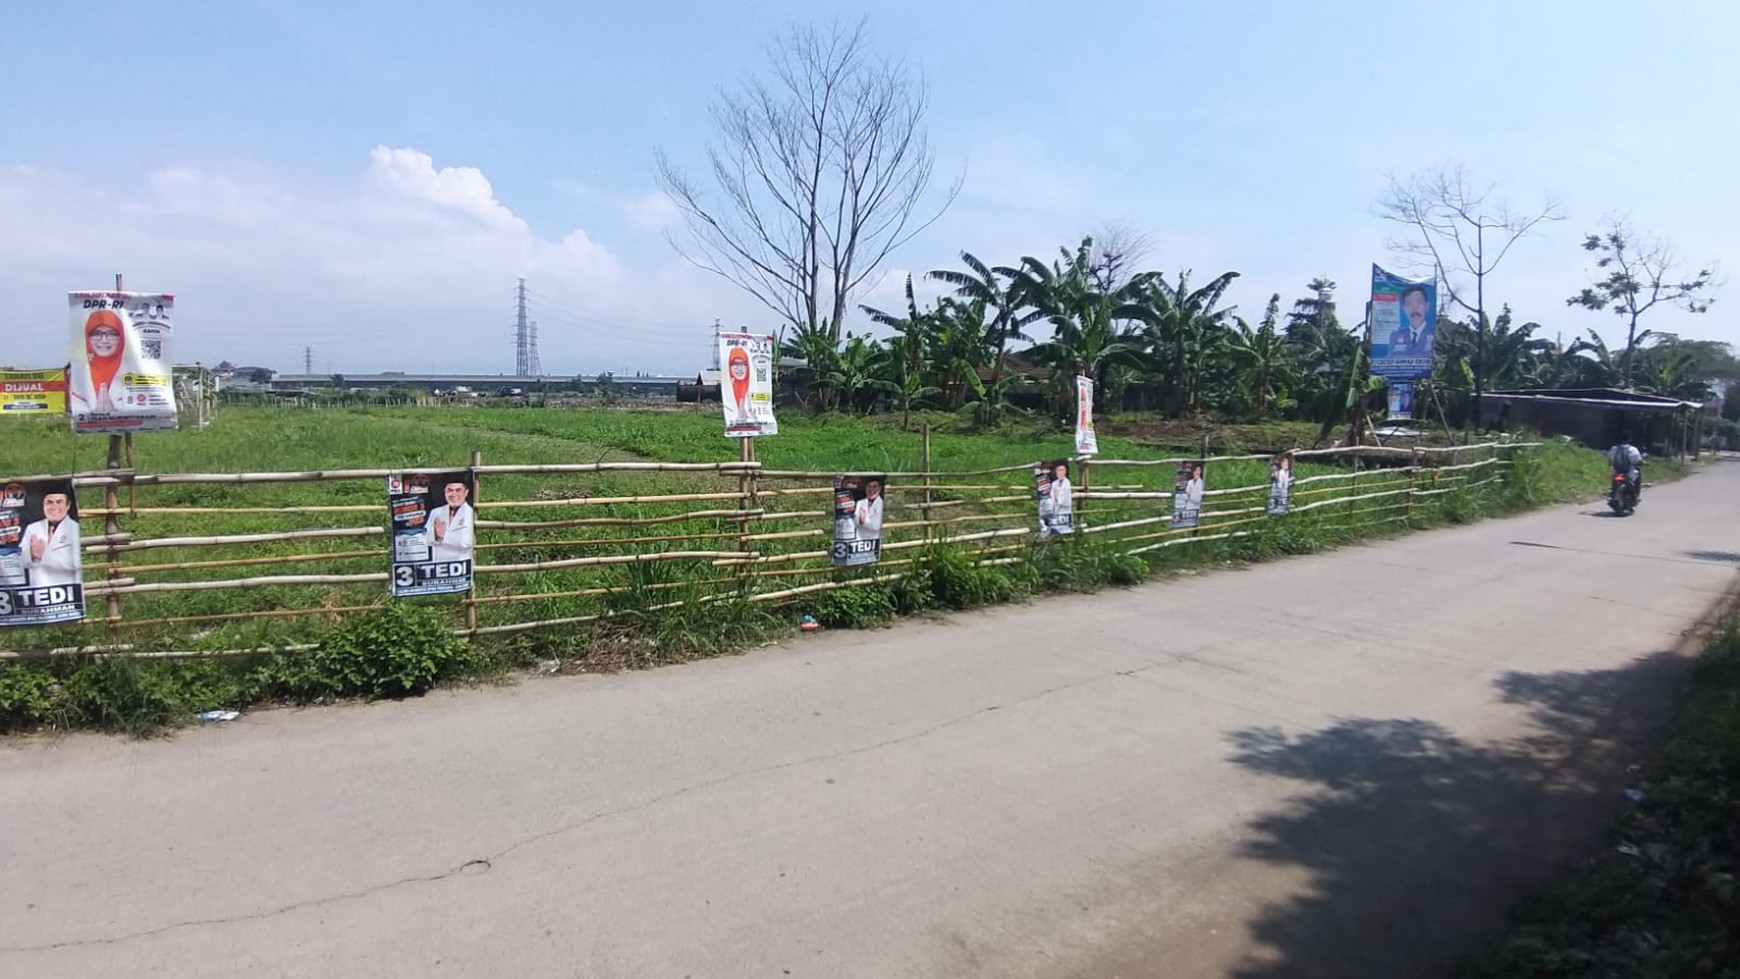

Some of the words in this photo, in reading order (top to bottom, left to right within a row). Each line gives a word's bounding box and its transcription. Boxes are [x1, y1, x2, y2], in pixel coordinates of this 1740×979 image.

[84, 299, 124, 309] DPR-RI
[5, 383, 44, 392] DIJUAL
[834, 543, 846, 558] 3
[851, 540, 876, 553] TEDI
[396, 566, 413, 587] 3
[420, 562, 467, 578] TEDI
[18, 586, 74, 606] TEDI
